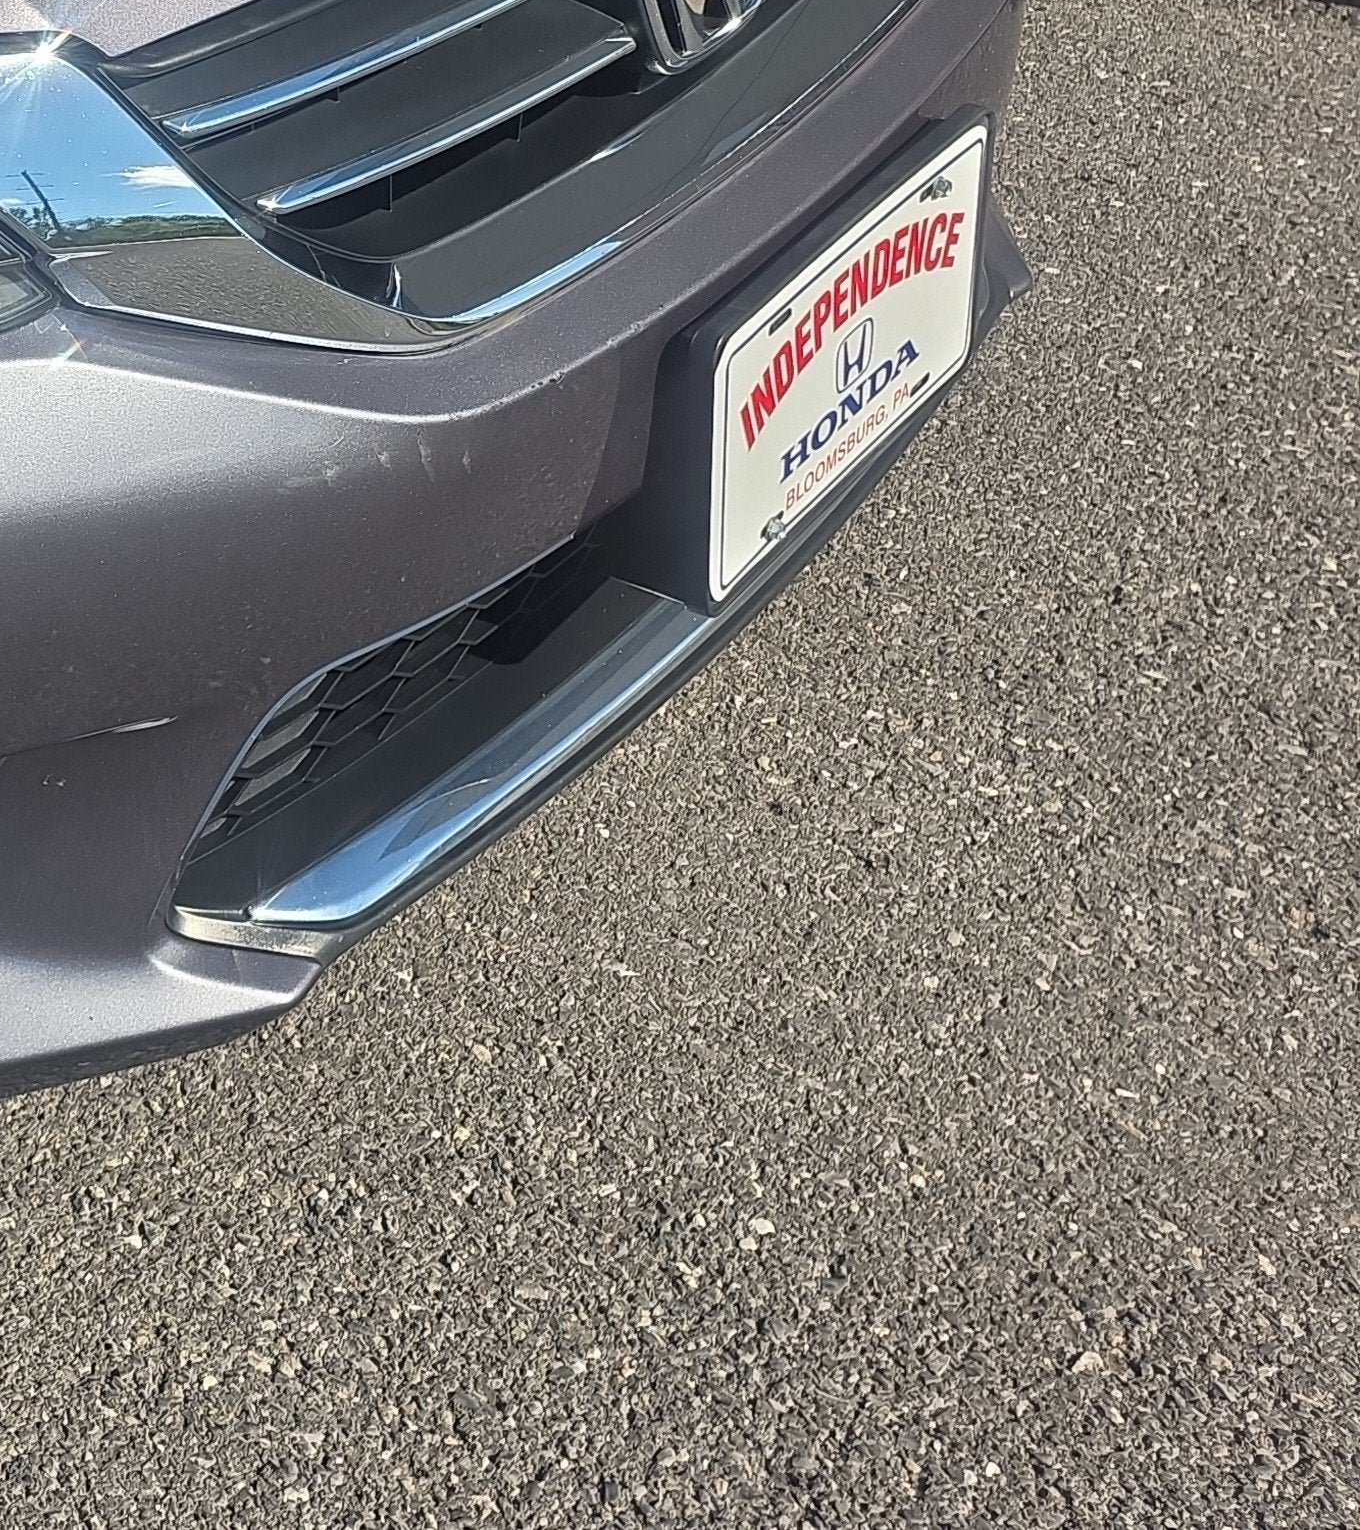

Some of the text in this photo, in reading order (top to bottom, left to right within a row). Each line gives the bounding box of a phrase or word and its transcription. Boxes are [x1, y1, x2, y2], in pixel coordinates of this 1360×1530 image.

[739, 211, 966, 453] INDEPENDENCE
[779, 339, 921, 485] HONDA
[785, 381, 910, 511] BLOOMSBURG, PA
